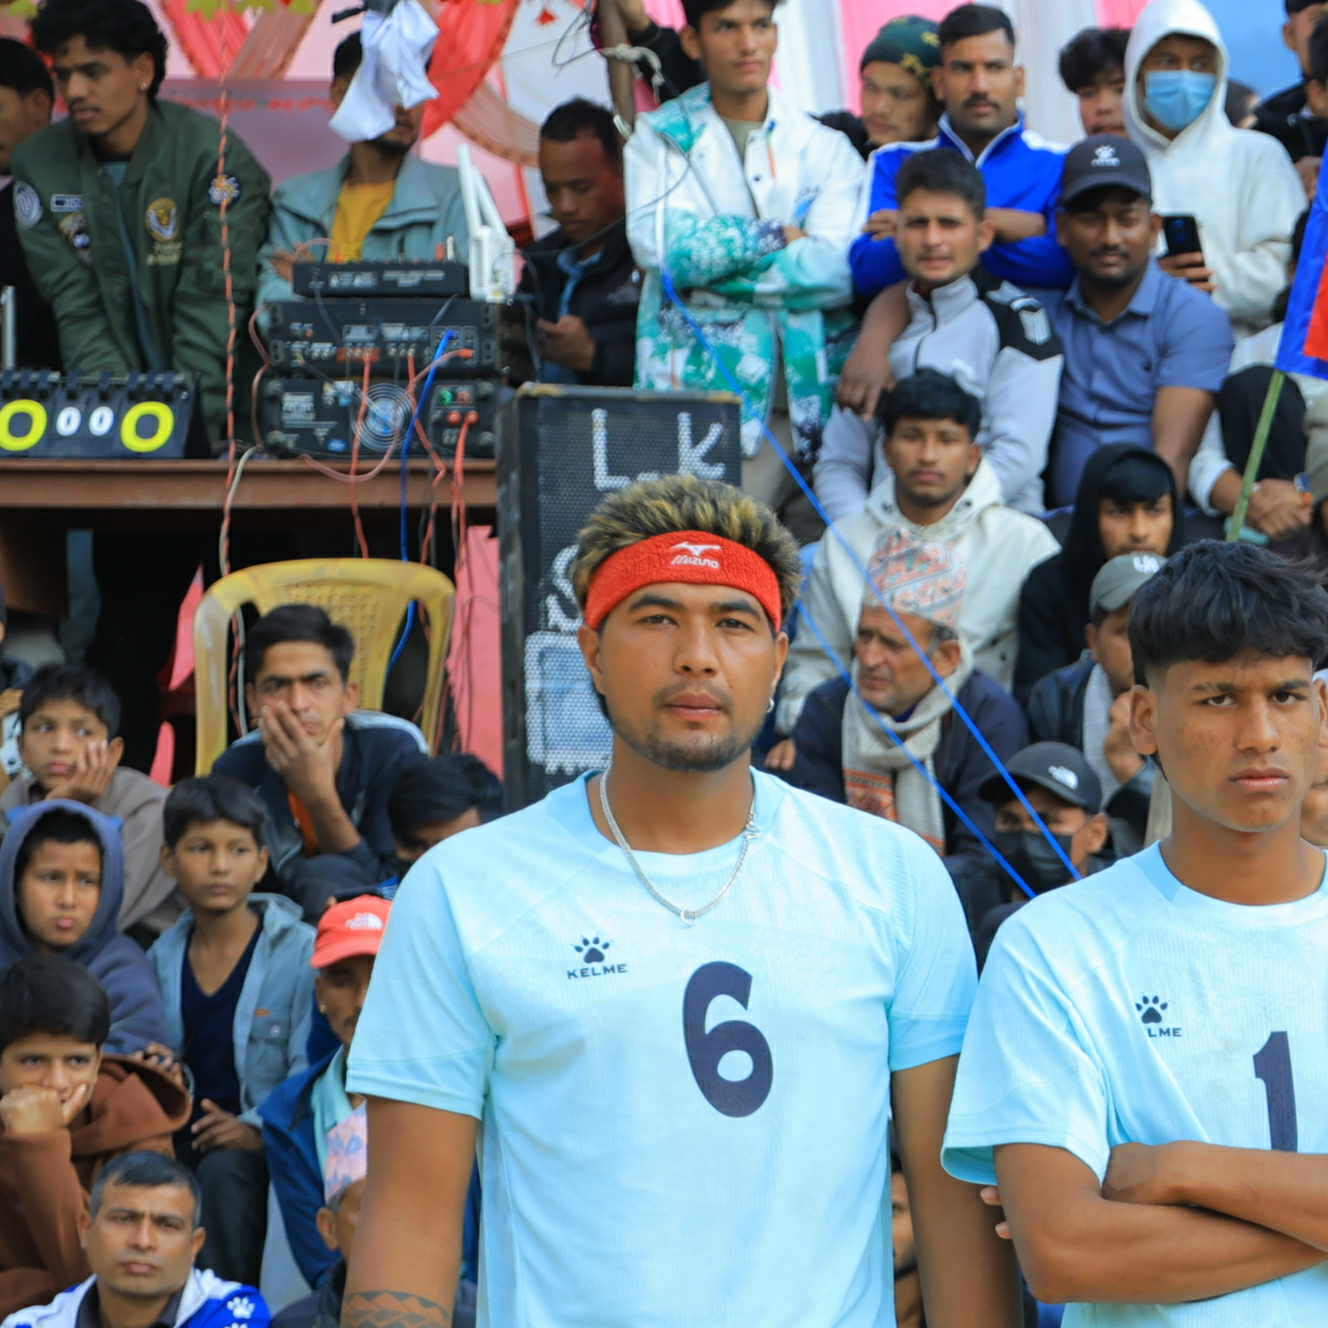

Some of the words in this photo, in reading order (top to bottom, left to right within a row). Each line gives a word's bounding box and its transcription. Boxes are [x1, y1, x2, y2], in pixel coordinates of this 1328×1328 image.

[120, 401, 175, 453] 0
[566, 963, 627, 980] KELME
[682, 961, 773, 1118] 6
[1147, 1027, 1183, 1039] LME
[1252, 1031, 1298, 1153] 1
